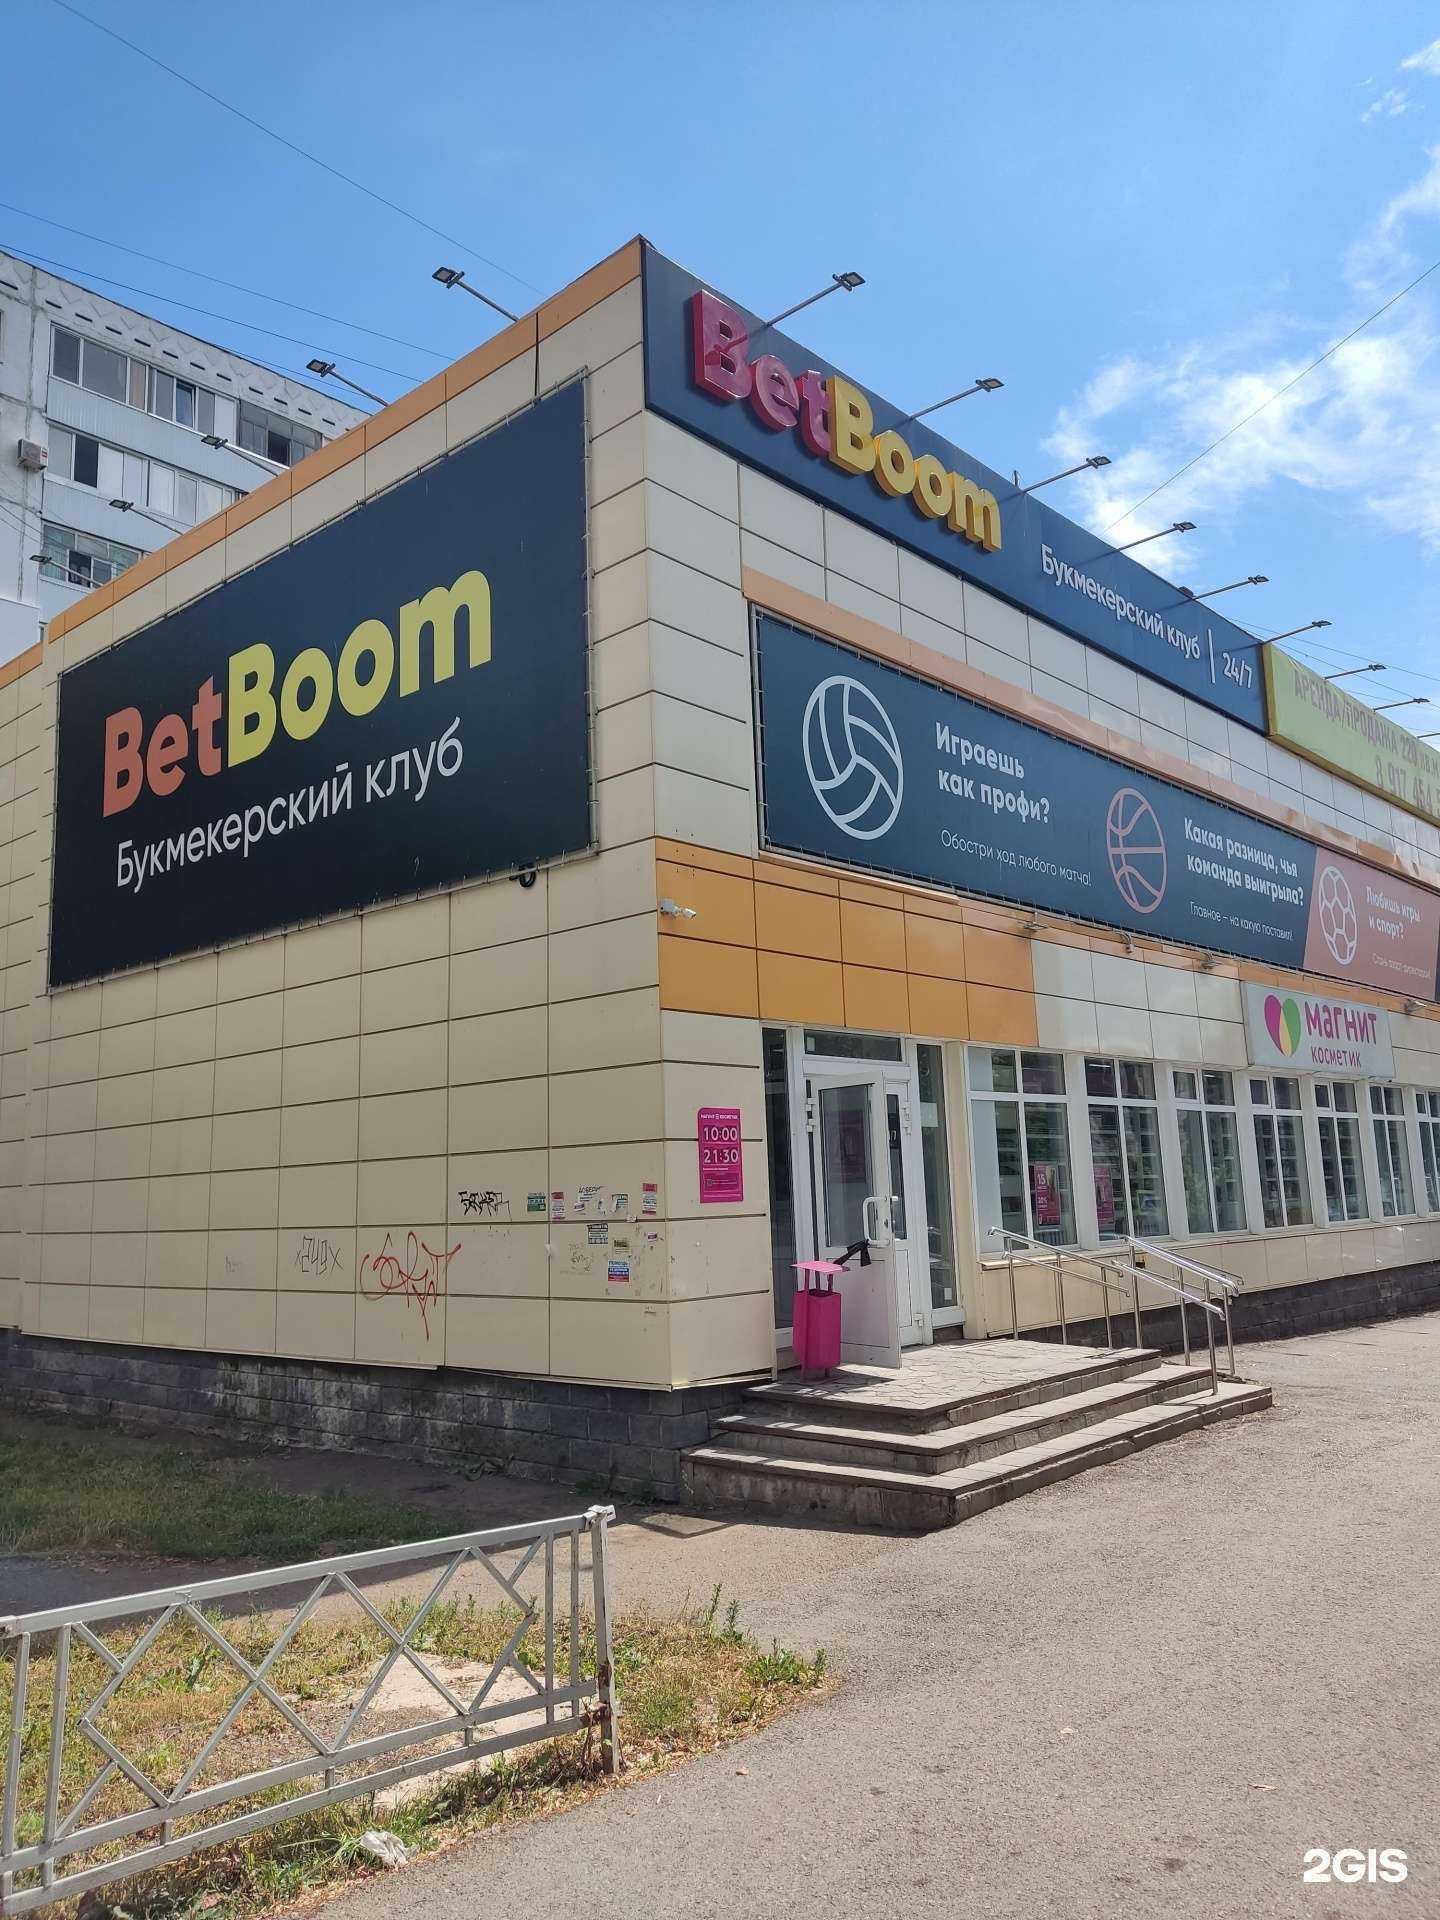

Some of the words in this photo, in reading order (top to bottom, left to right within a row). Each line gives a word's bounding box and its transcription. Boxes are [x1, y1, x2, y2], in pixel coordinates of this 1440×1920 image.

[691, 288, 1002, 553] BetBoom
[1041, 543, 1164, 640] Букмекерский
[1167, 625, 1201, 660] клуб
[1223, 652, 1253, 689] 24/7
[103, 570, 492, 818] BetBoom
[935, 721, 1025, 780] Играешь
[116, 762, 354, 894] Букмекерский
[366, 717, 464, 803] клуб
[938, 769, 975, 800] как
[980, 783, 1050, 824] профи?
[941, 829, 994, 860] Обостри
[996, 848, 1017, 866] ход
[1018, 854, 1057, 876] любого
[1059, 866, 1092, 887] матча!
[1184, 817, 1224, 852] Какая
[1226, 838, 1279, 875] разница,
[1280, 857, 1298, 878] чья
[1187, 854, 1242, 888] команда
[1190, 901, 1222, 922] Главное
[1230, 915, 1239, 928] на
[1240, 918, 1261, 935] какую
[703, 1127, 738, 1141] 10:00
[703, 1149, 739, 1163] 21:30
